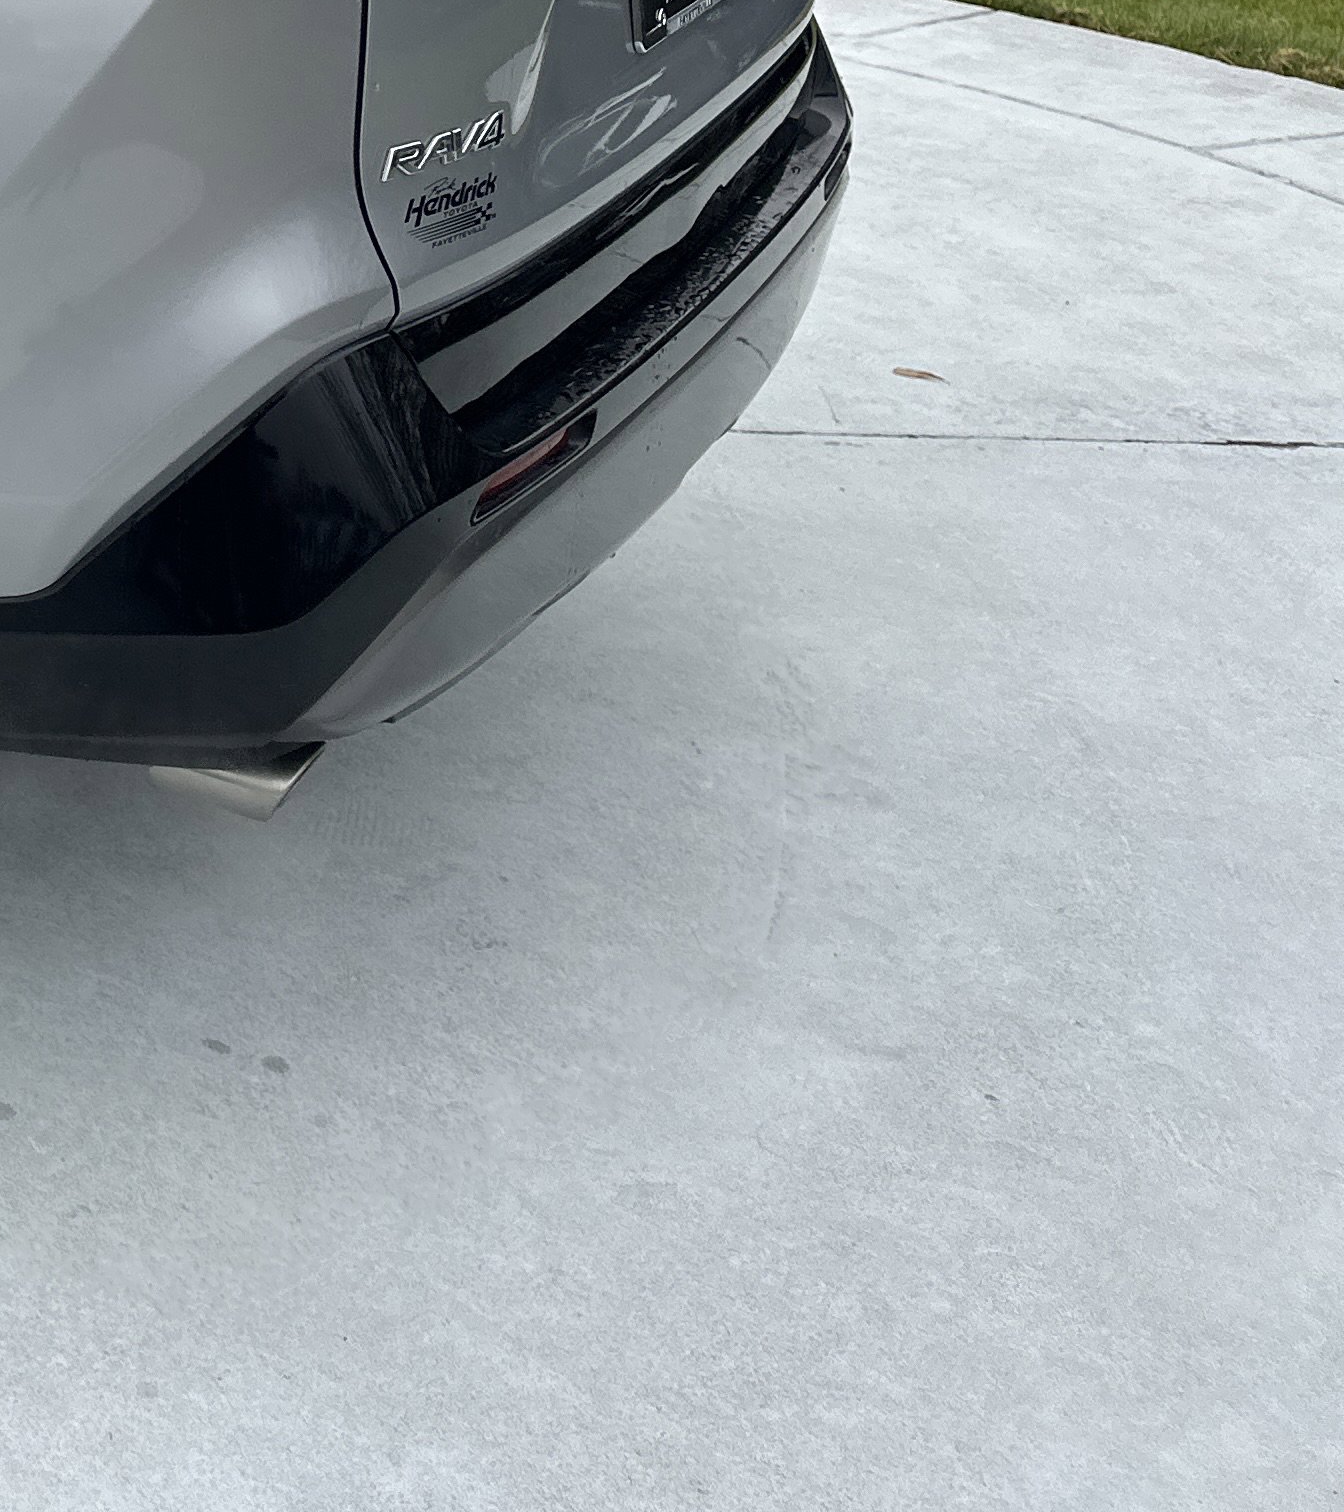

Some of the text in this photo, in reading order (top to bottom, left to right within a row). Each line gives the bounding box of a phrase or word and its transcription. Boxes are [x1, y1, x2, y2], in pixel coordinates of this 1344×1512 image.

[380, 109, 506, 182] RAV4
[404, 172, 498, 228] Hendrick
[443, 201, 479, 218] TOYOTA
[432, 224, 488, 249] FAYETTEVILLE
